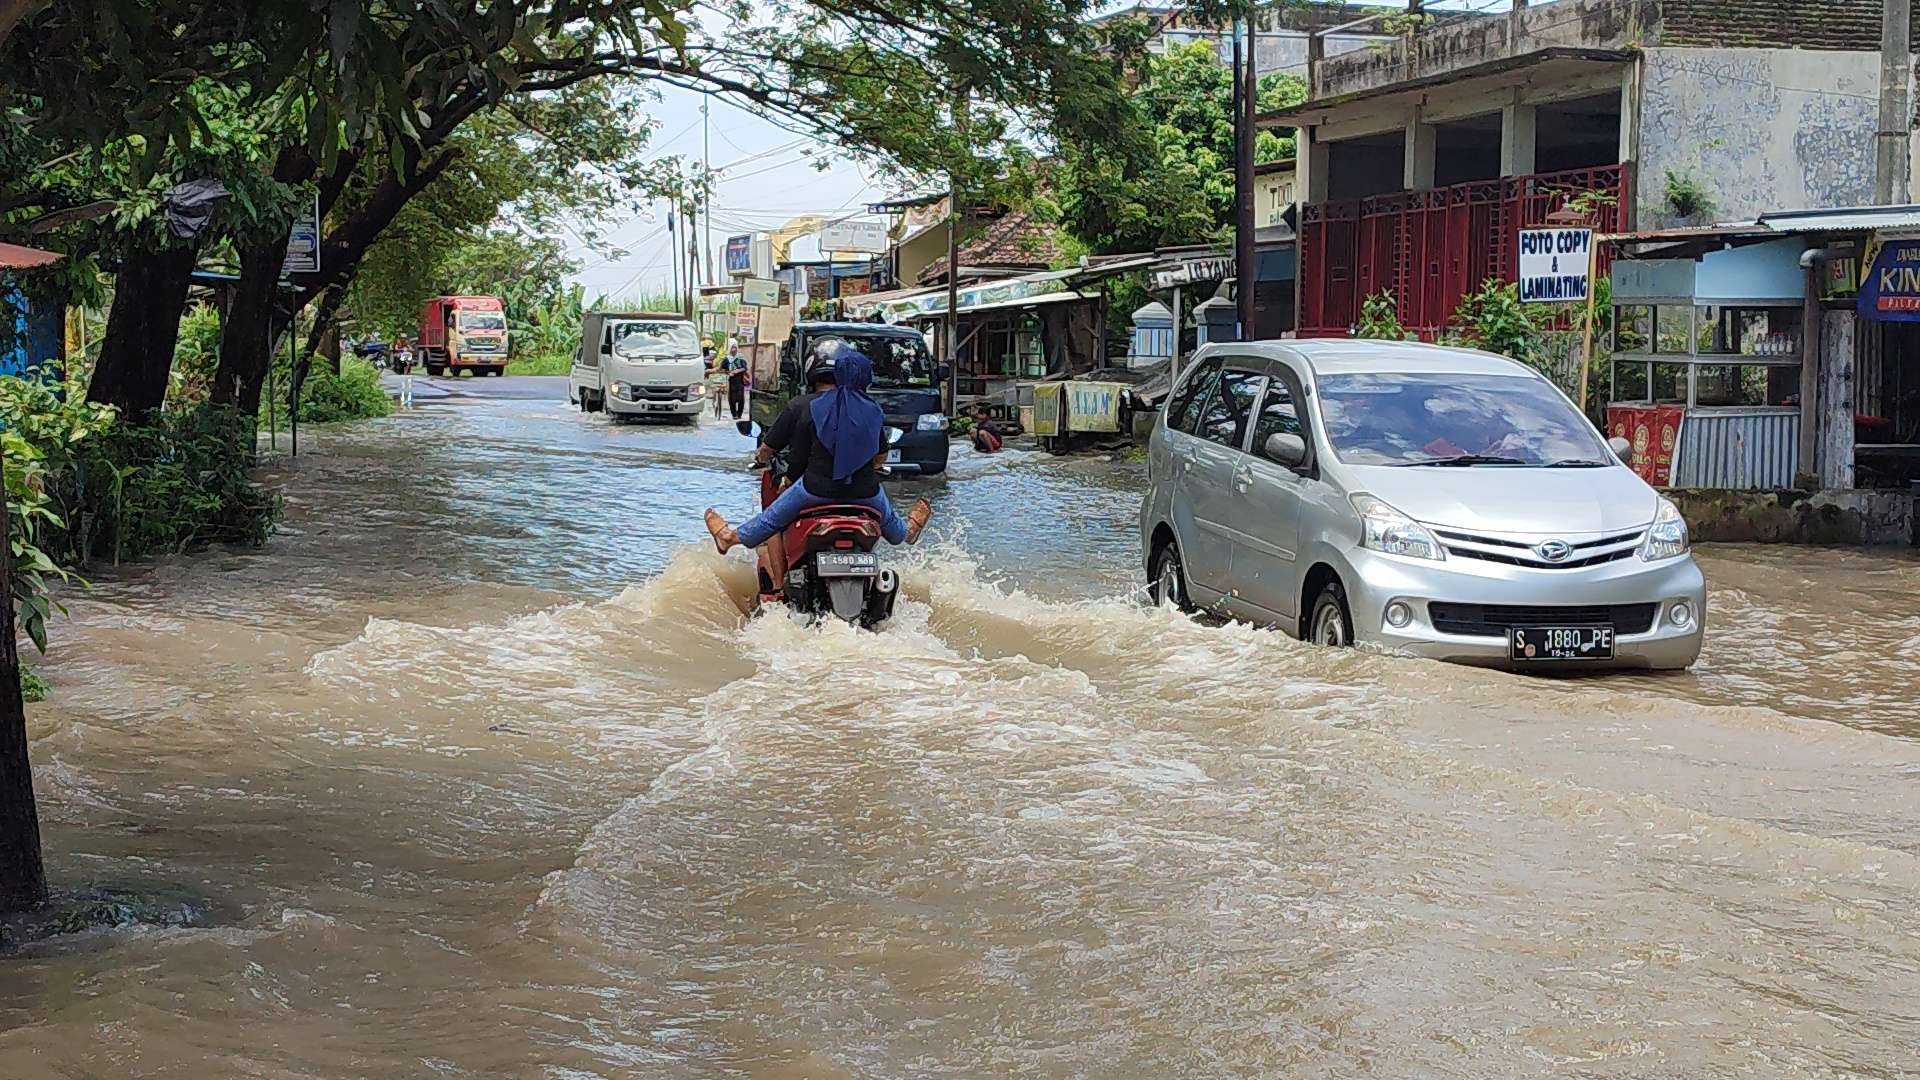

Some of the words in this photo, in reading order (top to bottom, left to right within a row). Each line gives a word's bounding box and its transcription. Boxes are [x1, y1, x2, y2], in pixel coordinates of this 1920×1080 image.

[1521, 231, 1553, 255] FOTO
[1557, 230, 1590, 253] COPY
[1551, 255, 1559, 272] &
[1521, 274, 1587, 299] LAMINATING
[1516, 630, 1525, 649] S
[1547, 629, 1581, 649] 1880
[1592, 629, 1611, 649] PE
